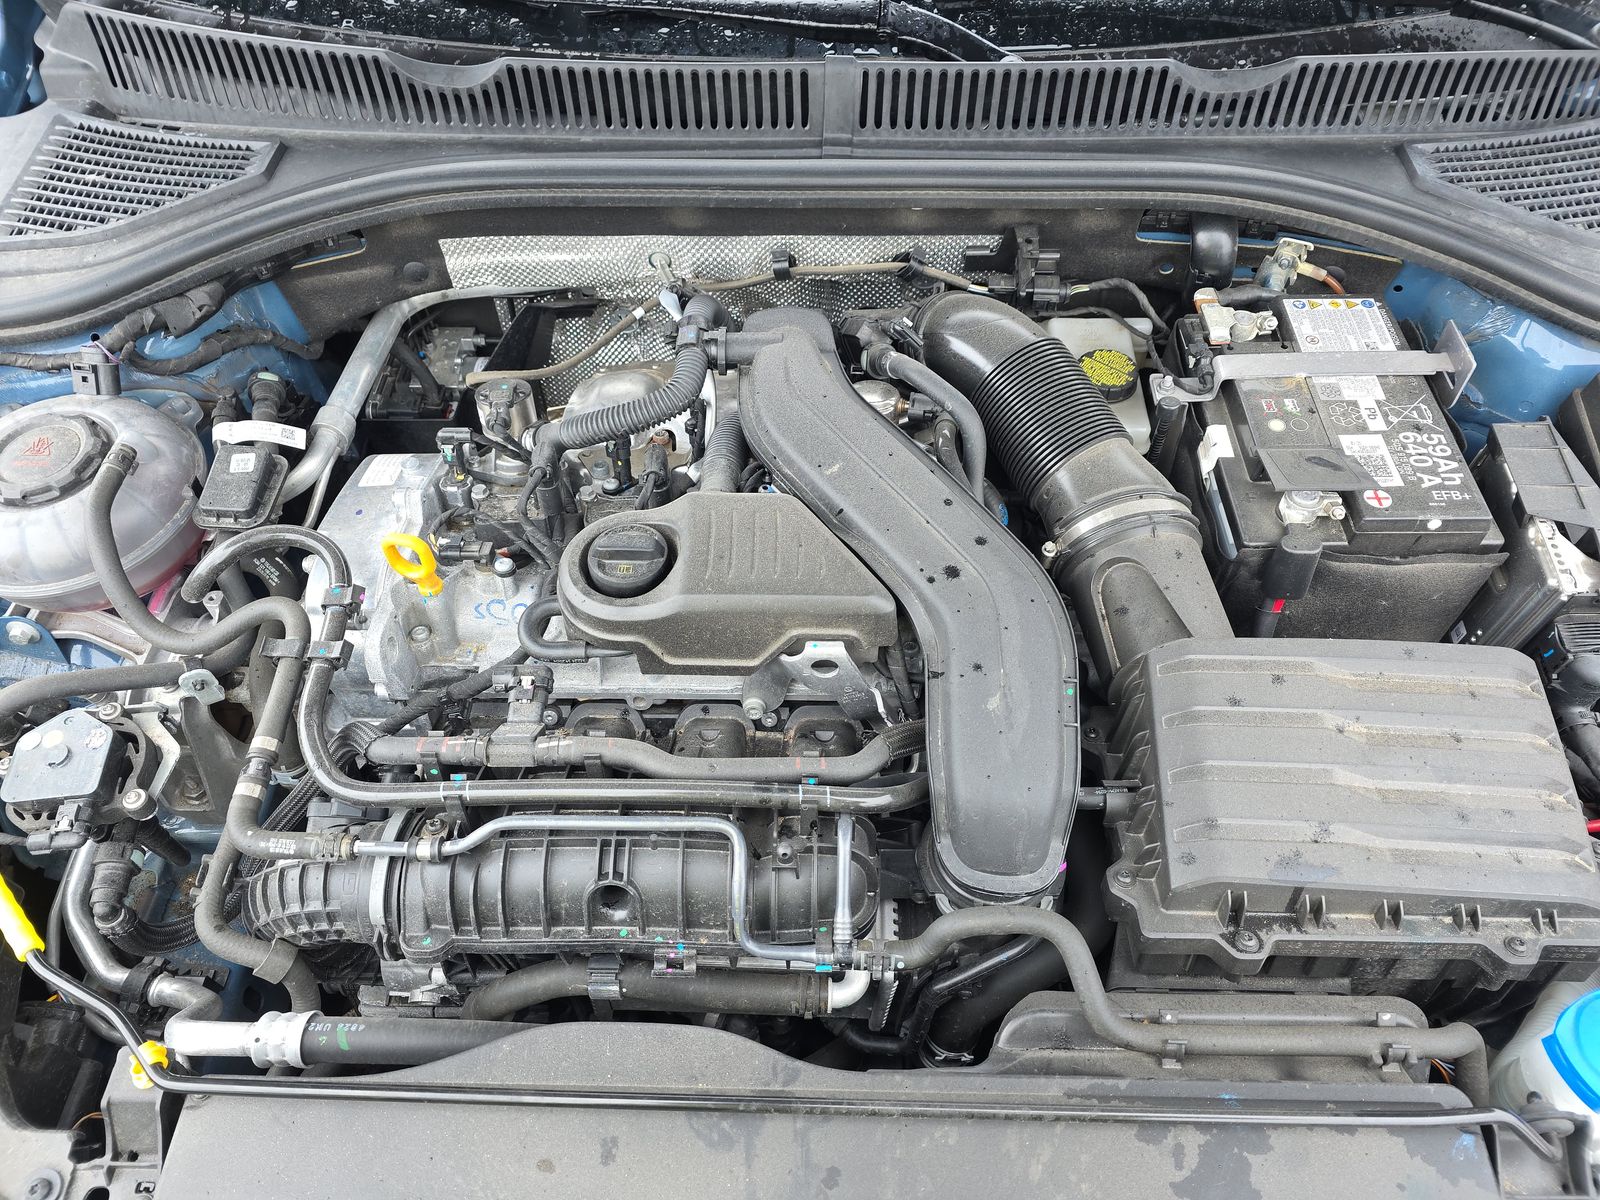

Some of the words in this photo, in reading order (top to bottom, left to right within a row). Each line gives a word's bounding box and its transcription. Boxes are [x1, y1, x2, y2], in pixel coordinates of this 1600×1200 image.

[1364, 407, 1378, 420] Pb
[1399, 431, 1433, 467] 640
[1416, 472, 1443, 488] A
[1422, 433, 1464, 485] 59Ah
[1431, 490, 1472, 501] EFB+
